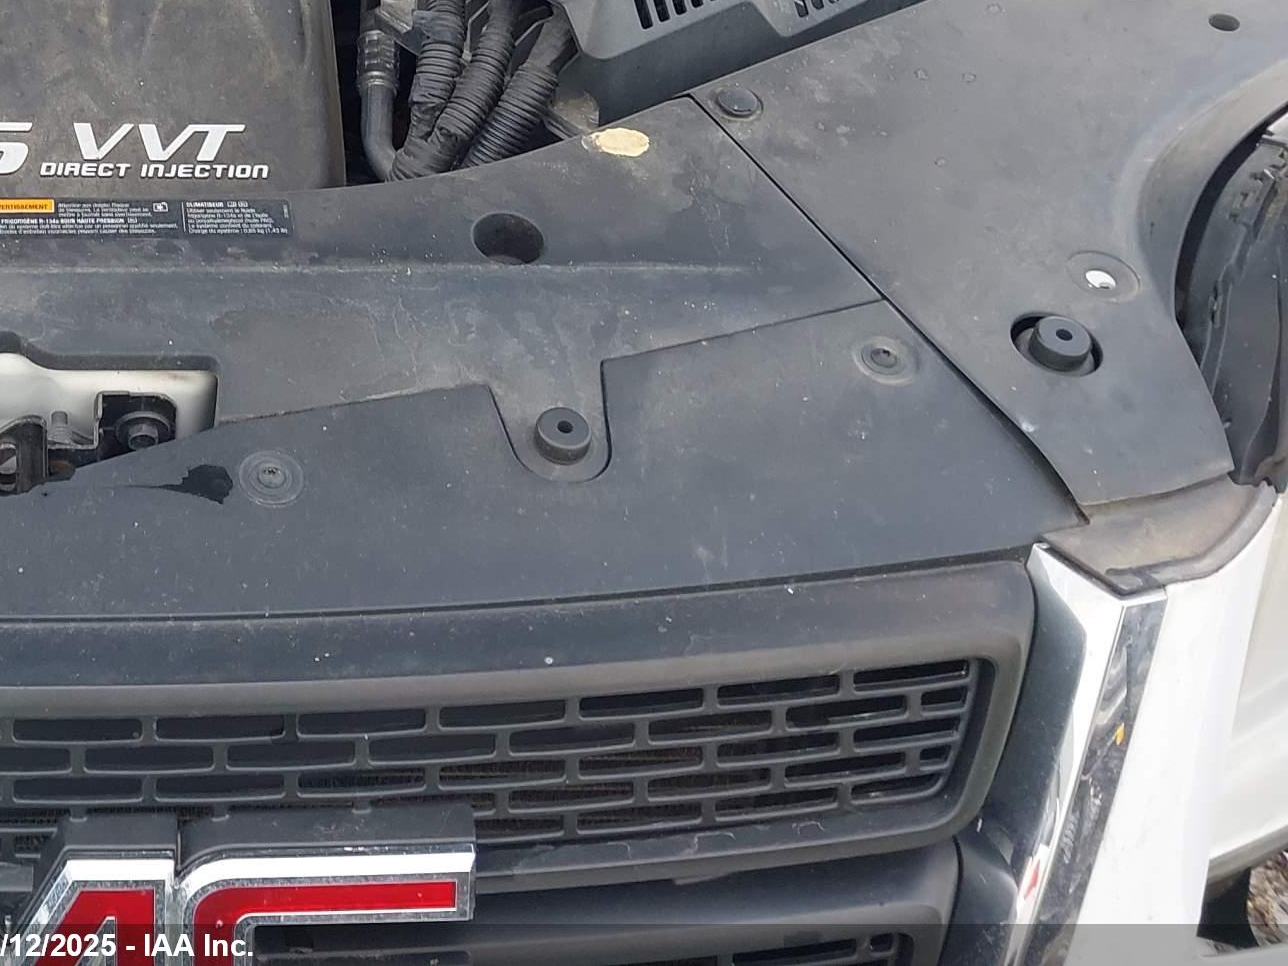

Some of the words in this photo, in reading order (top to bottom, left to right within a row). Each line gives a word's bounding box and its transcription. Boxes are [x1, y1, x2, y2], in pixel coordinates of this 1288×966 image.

[73, 123, 246, 161] VVT
[40, 163, 131, 179] DIRECT
[140, 163, 269, 179] INJECTION
